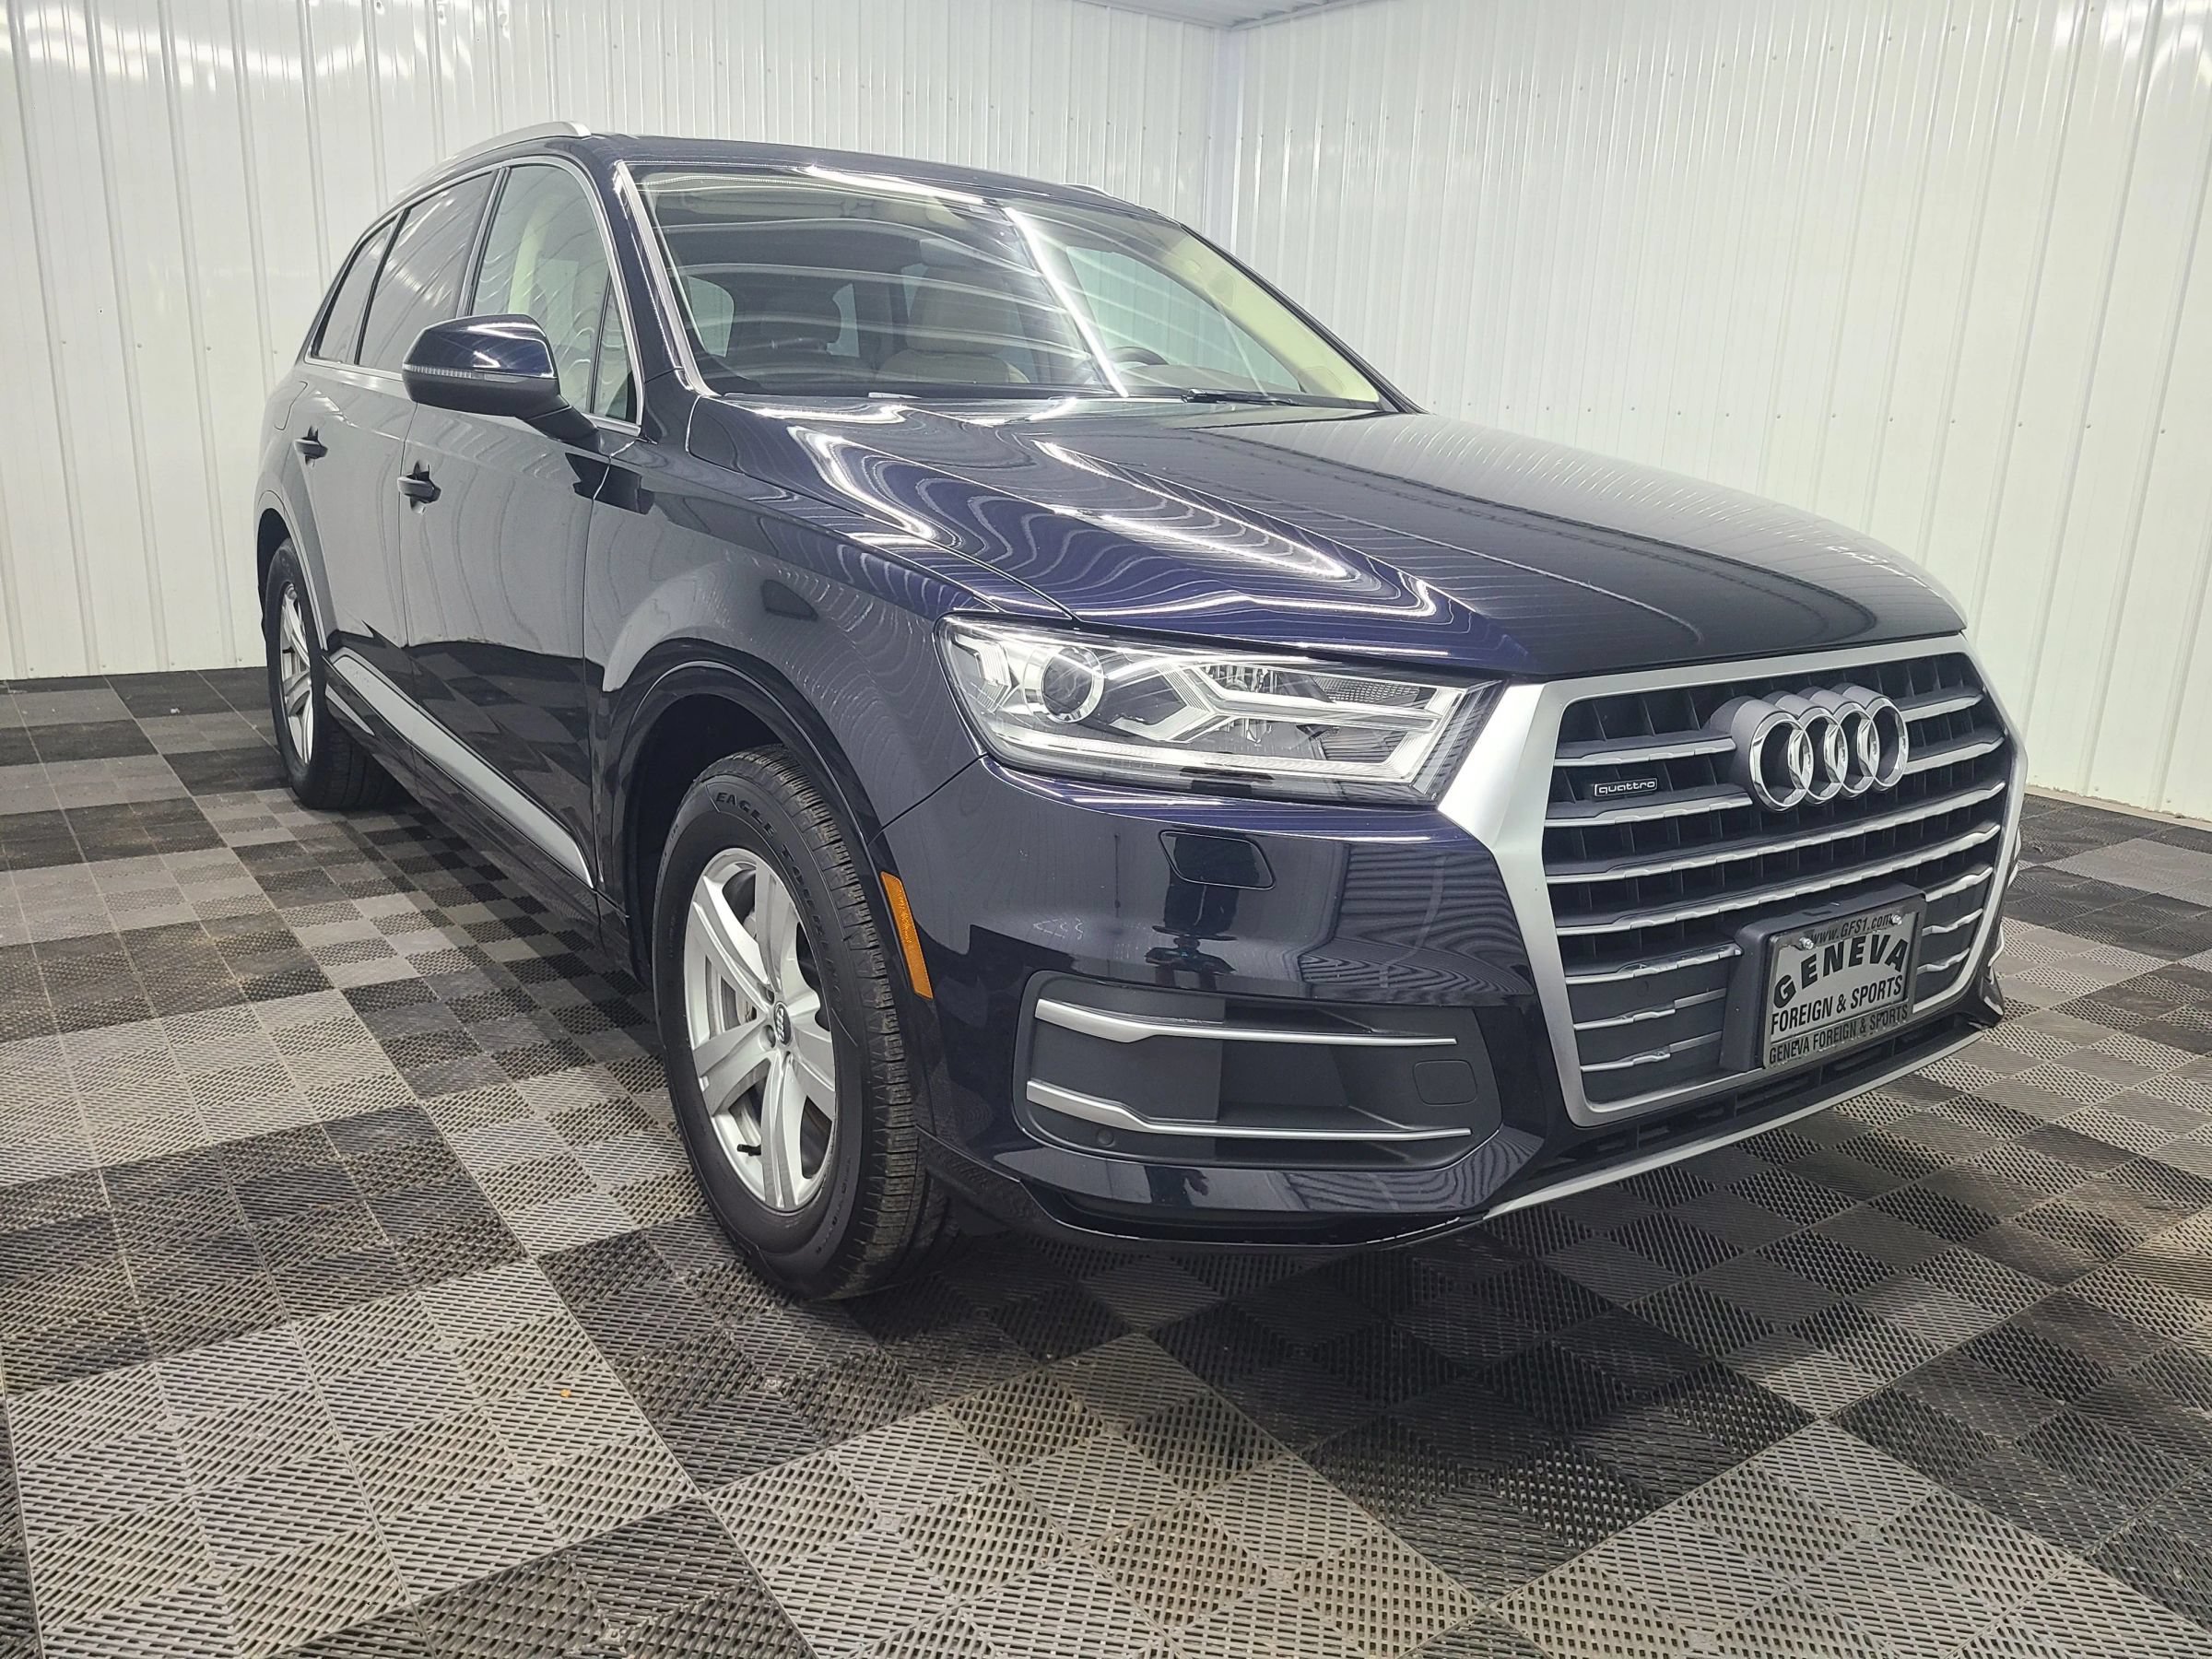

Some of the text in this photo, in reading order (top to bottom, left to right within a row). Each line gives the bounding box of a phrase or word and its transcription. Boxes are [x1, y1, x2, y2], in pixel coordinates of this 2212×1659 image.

[715, 792, 777, 839] EAGLE
[1598, 781, 1655, 794] quattro
[1773, 934, 1909, 1009] GENEVA
[1769, 1004, 1908, 1065] GENEVA FOREIGN & SPORTS
[1771, 974, 1903, 1035] FOREIGN & SPORTS
